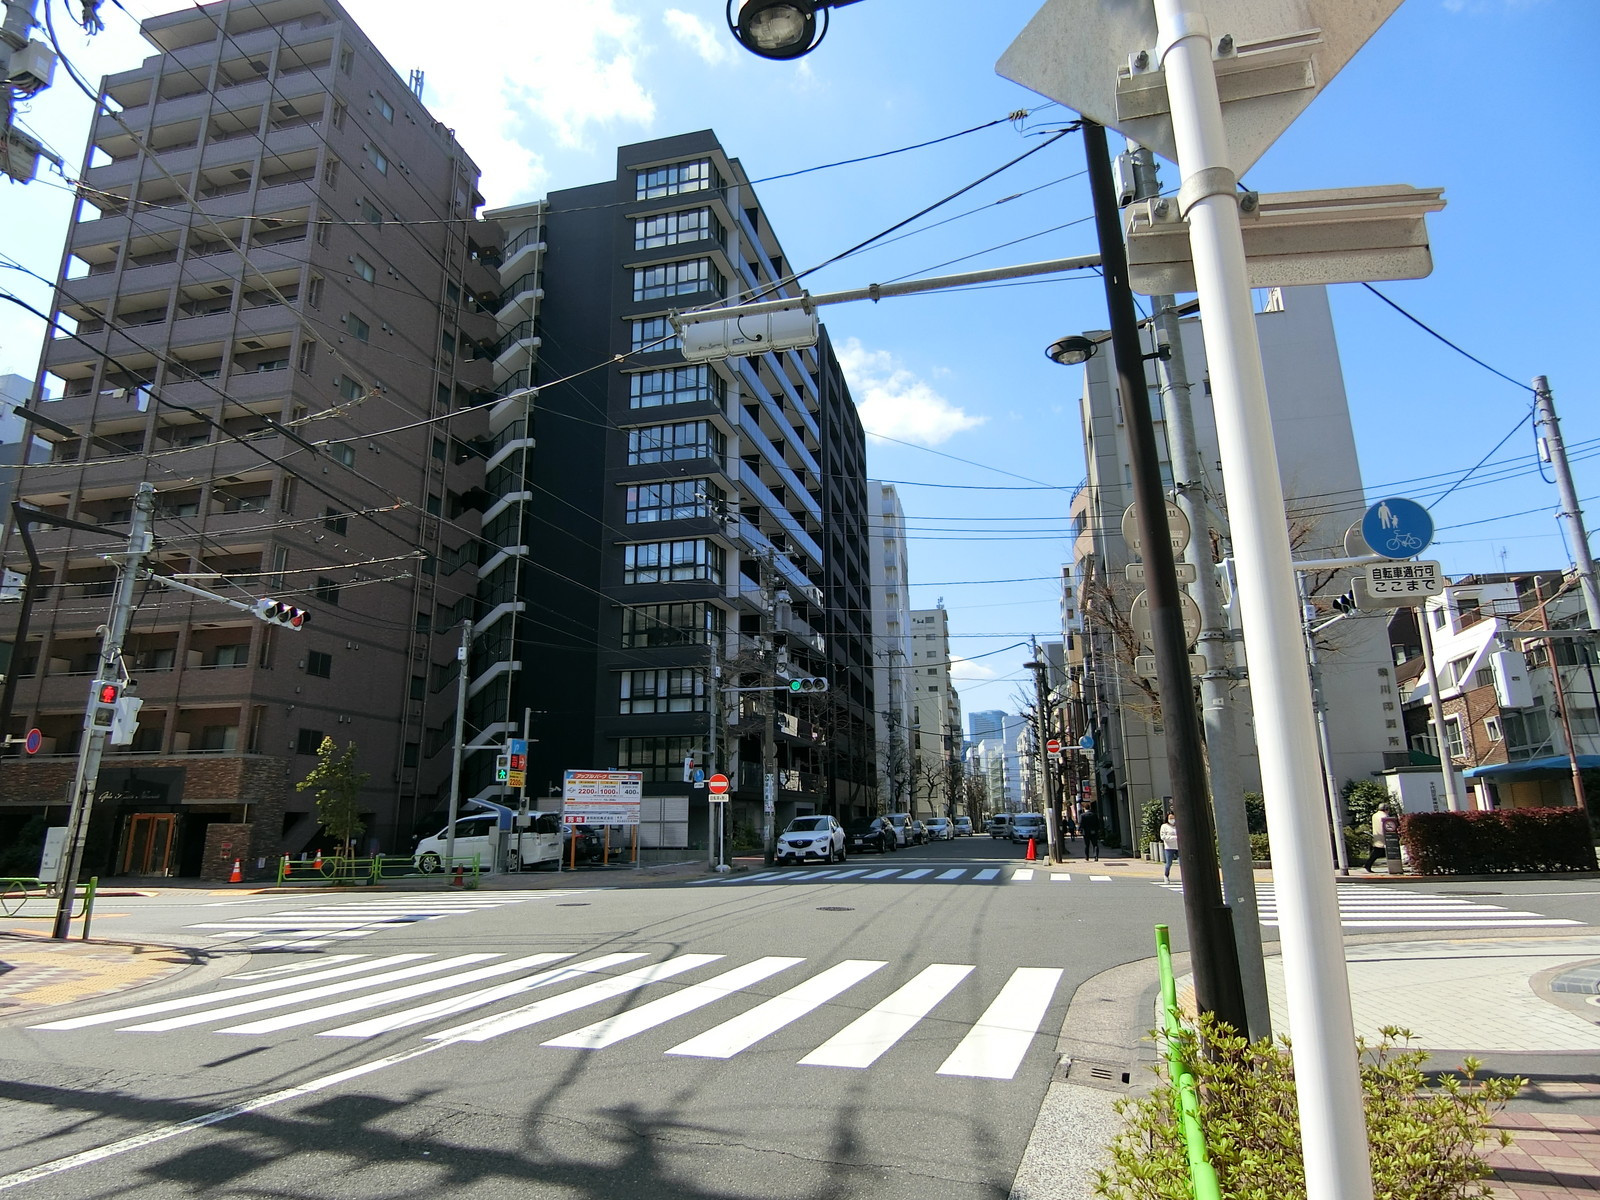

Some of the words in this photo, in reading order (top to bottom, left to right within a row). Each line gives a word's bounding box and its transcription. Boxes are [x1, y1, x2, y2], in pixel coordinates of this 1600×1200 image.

[1372, 565, 1434, 579] 自転車通行可
[1375, 580, 1436, 593] ここまで
